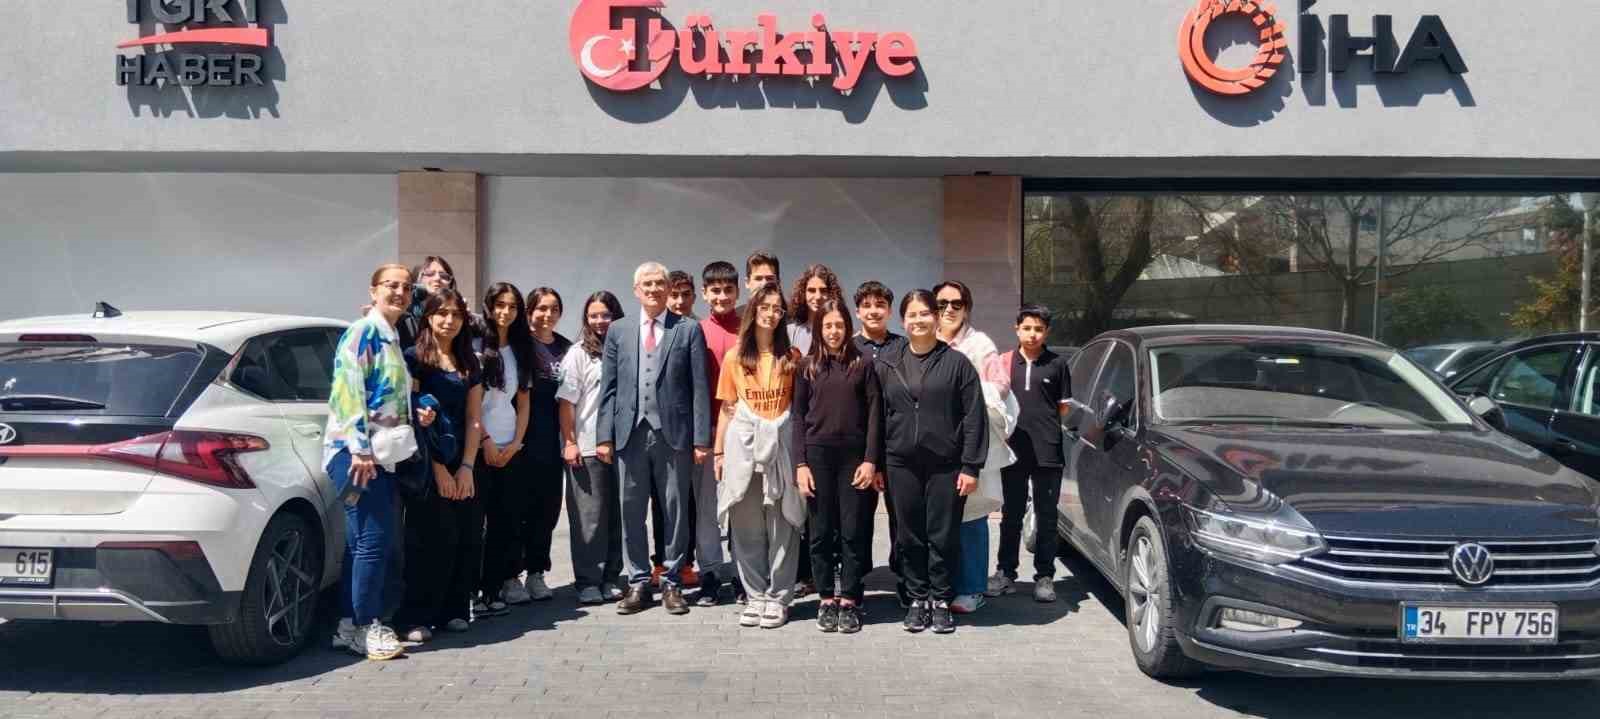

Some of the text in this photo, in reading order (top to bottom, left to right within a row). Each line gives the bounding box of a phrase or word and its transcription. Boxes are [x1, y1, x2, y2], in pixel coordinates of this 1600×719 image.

[608, 5, 918, 91] Türkiye
[116, 54, 264, 86] HABER
[16, 551, 49, 575] 615
[1420, 611, 1553, 636] 34 FPY 756
